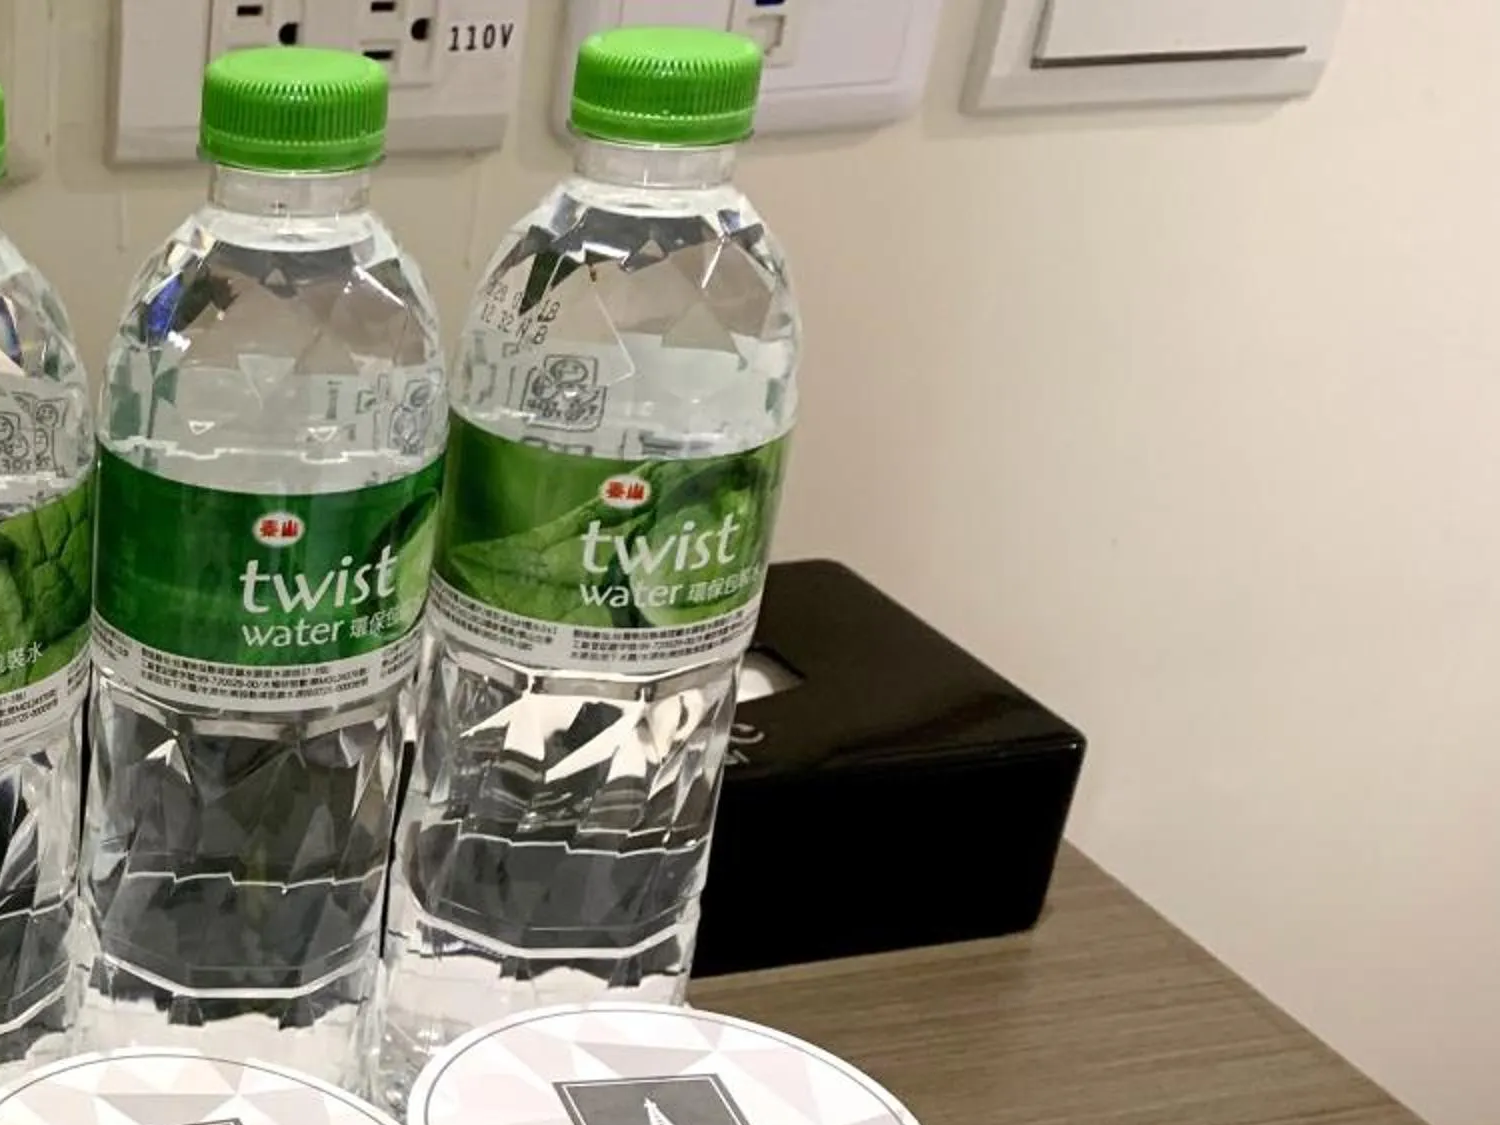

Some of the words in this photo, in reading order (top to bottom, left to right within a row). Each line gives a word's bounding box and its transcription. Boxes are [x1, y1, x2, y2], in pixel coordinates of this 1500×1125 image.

[448, 23, 514, 51] 110V
[580, 512, 740, 574] twist
[239, 544, 398, 613] twist
[580, 581, 683, 609] water
[241, 617, 345, 648] water
